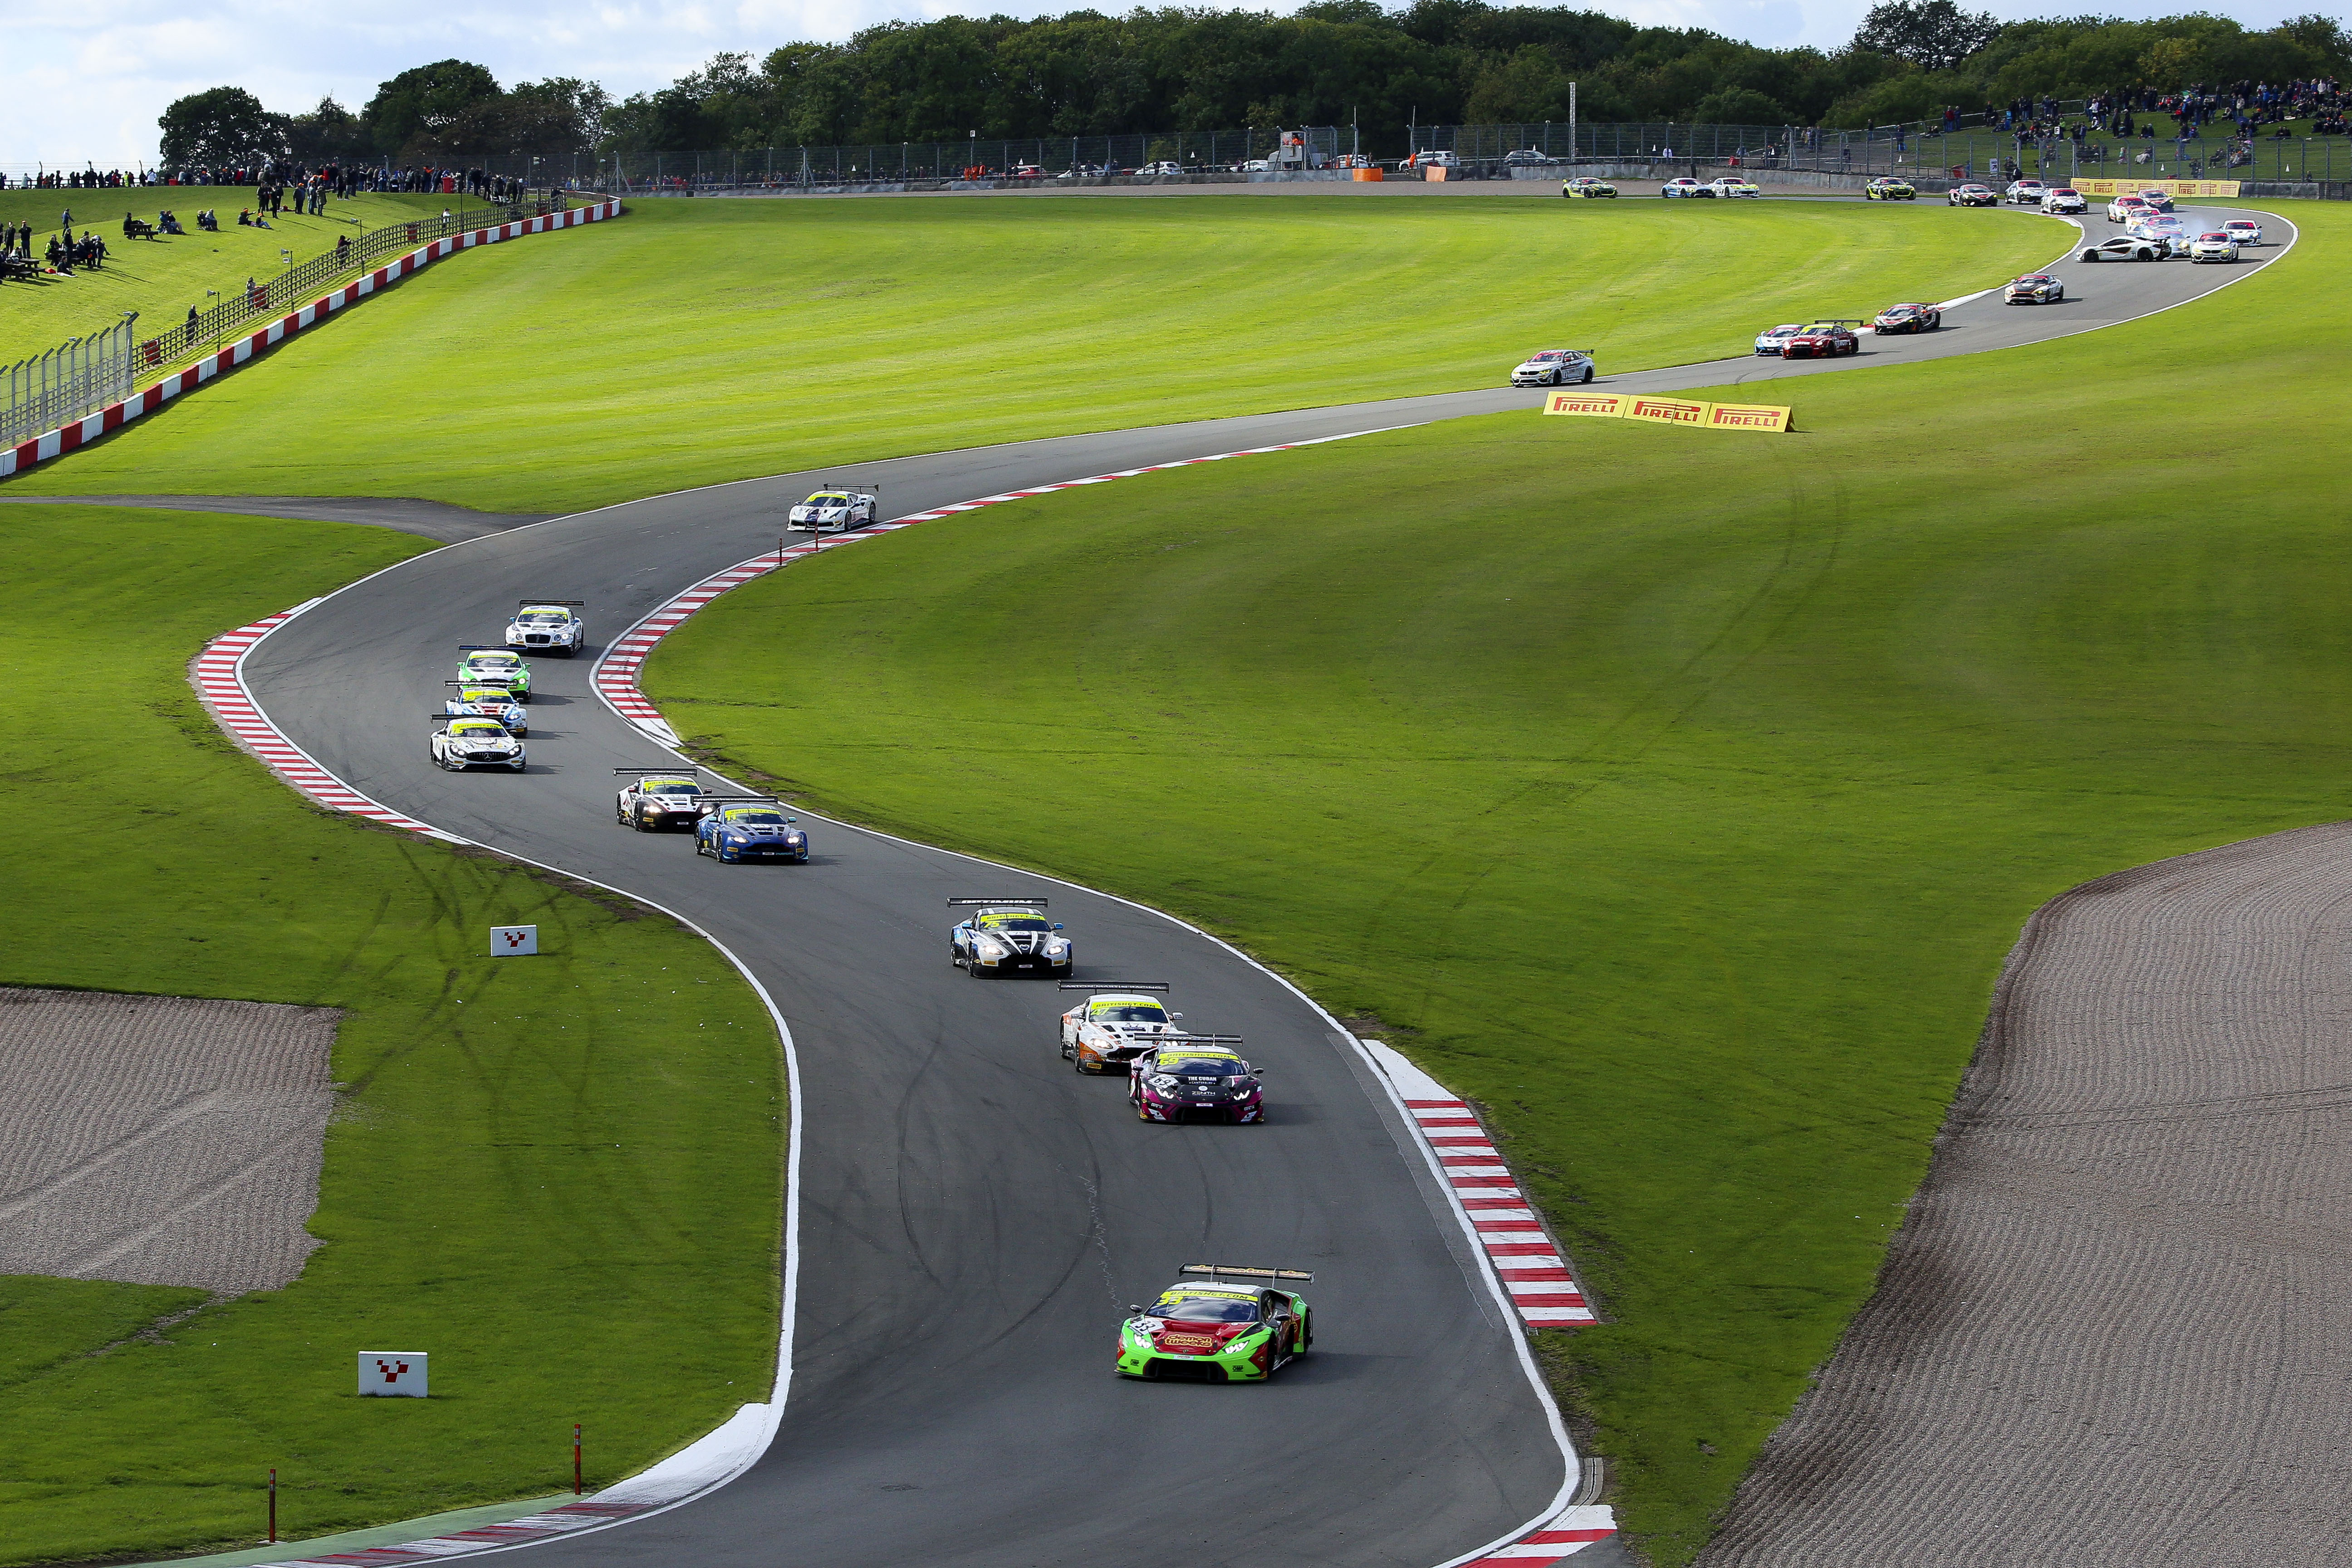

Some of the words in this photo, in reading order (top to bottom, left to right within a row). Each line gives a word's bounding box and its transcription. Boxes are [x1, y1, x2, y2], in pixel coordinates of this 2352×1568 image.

[2094, 182, 2113, 193] PIRELLI
[2179, 183, 2196, 194] PIRELLI
[2200, 184, 2217, 195] PIRELLI
[2221, 184, 2237, 195] PIRELLI
[1553, 397, 1618, 412] PIRELLI
[1633, 401, 1701, 421] PIRELLI
[1713, 408, 1781, 426] PIRELLI
[1154, 1077, 1172, 1086] 69
[1170, 1290, 1248, 1300] BRITISHGT.COM
[1156, 1297, 1184, 1305] 33
[1135, 1321, 1156, 1332] 33
[1165, 1339, 1213, 1348] tweeks
